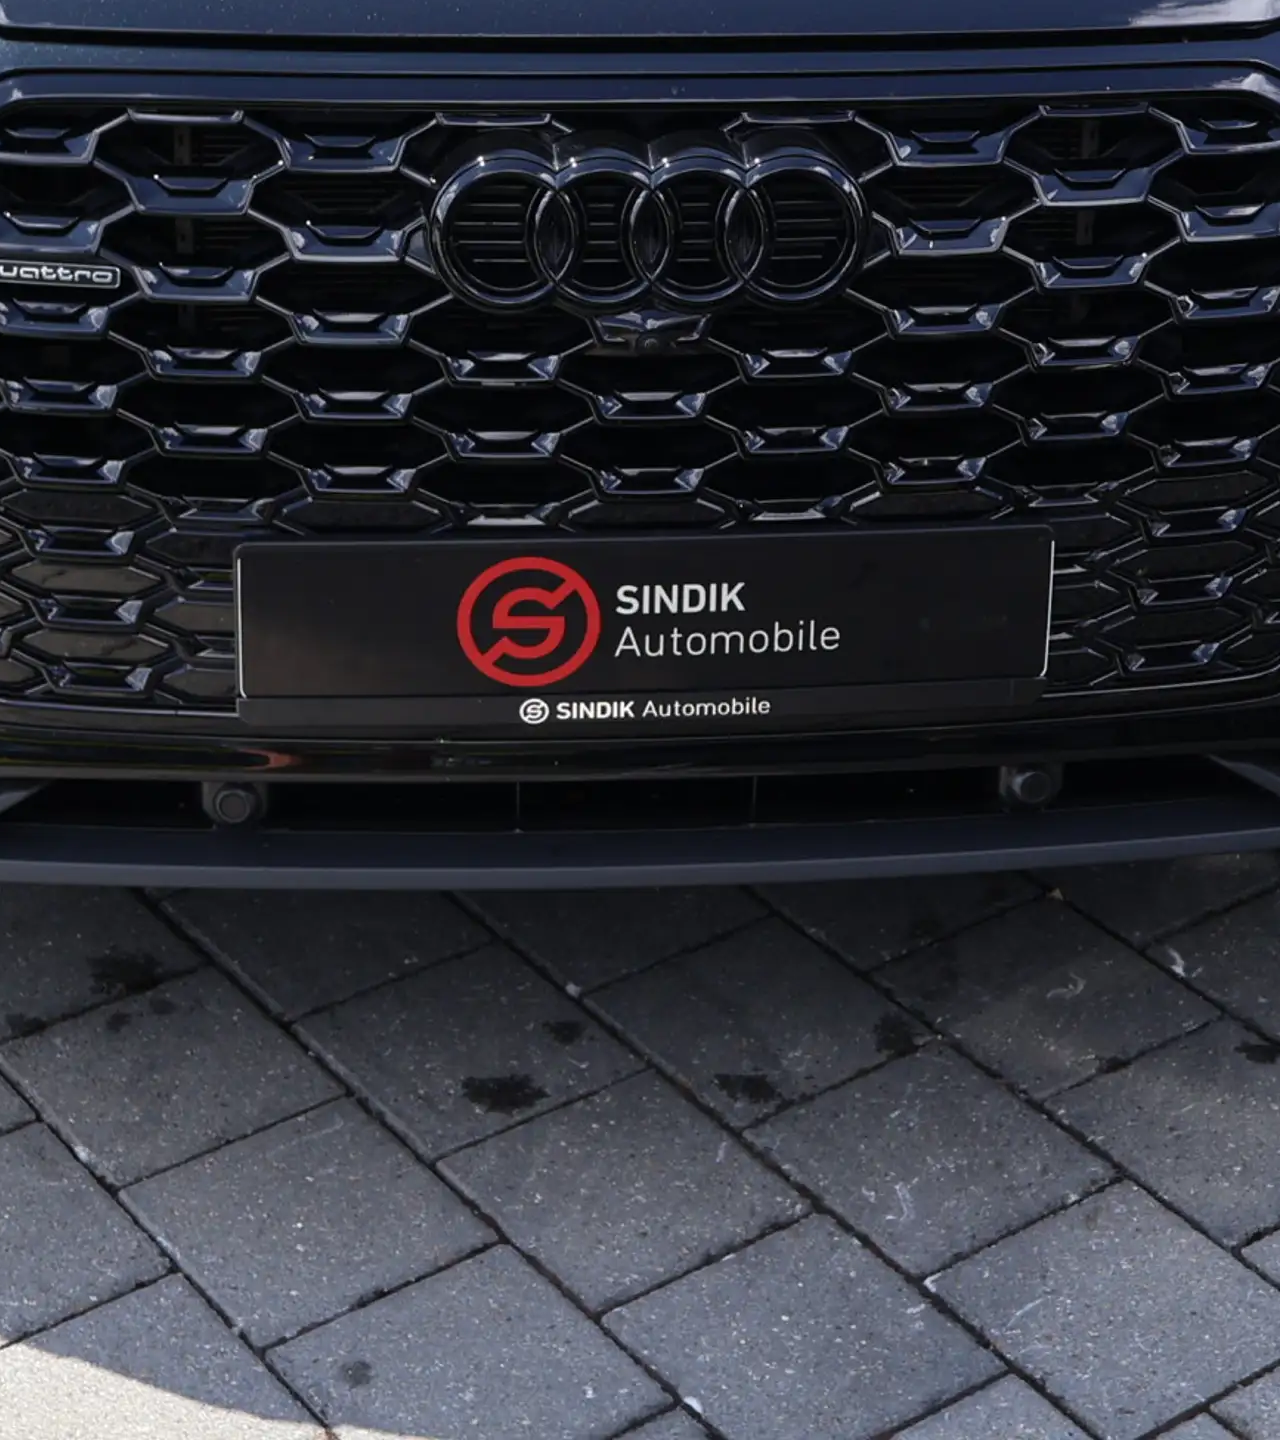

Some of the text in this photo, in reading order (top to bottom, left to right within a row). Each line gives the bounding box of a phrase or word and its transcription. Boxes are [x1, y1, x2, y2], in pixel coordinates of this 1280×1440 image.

[615, 581, 746, 615] SINDIK
[614, 619, 841, 658] Automobile
[556, 700, 635, 720] SINDIK
[641, 696, 771, 718] Automobile
